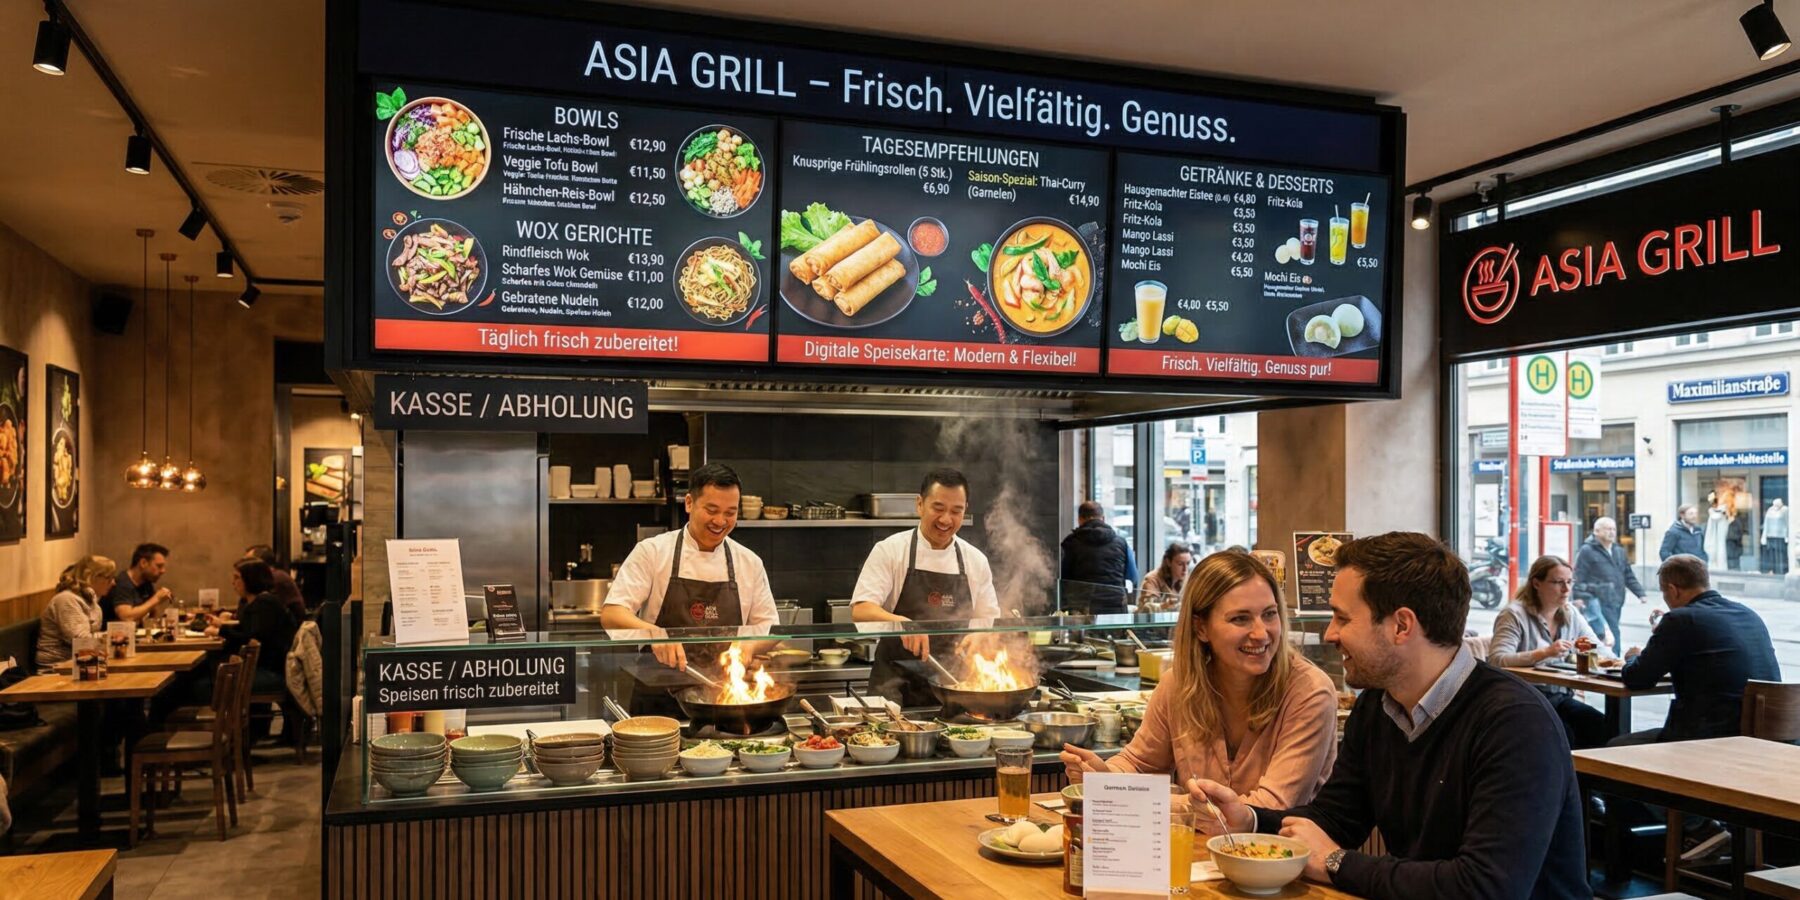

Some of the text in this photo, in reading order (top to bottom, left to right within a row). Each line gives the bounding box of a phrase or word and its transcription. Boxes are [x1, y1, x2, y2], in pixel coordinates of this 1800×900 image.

[584, 41, 677, 85] ASIA
[692, 52, 796, 98] GRILL
[843, 69, 953, 115] Frisch.
[964, 81, 1110, 137] Vielfältig.
[1121, 101, 1237, 144] Genuss.
[555, 106, 619, 130] BOWLS
[503, 127, 544, 142] Frische
[547, 131, 610, 147] Lachs-Bowl
[629, 138, 666, 152] €12,90
[862, 135, 1039, 168] TAGESEMPFEHLUNGEN
[503, 155, 542, 171] Veggie
[544, 158, 569, 172] Tofu
[572, 161, 598, 174] Bowl
[629, 165, 666, 180] €11,50
[793, 155, 953, 181] Knusprige Frühlingsrollen (5 Stk.)
[923, 182, 950, 196] €6,90
[968, 170, 1086, 193] Saison-Spezial: Thai-Curry
[1180, 165, 1334, 195] GETRÄNKE & DESSERTS
[503, 182, 666, 206] Hähnchen-Reis-Bowl €12,50
[968, 186, 1100, 208] (Garnelen) €14,90
[1124, 183, 1188, 199] Hausgemachter
[1189, 189, 1214, 201] Eistee
[1233, 192, 1257, 205] €4,80
[1267, 195, 1303, 209] Fritz-Kola
[1123, 198, 1256, 219] Fritz-Kola €3,50
[516, 220, 653, 246] WOX GERICHTE
[1123, 213, 1255, 234] Fritz-Kola €3,50
[1122, 228, 1255, 249] Mango Lassi €3,50
[502, 245, 664, 267] Rindfleisch Wok €13,90
[1122, 243, 1254, 263] Mango Lassi €4,20
[1356, 257, 1378, 269] €5,50
[1530, 209, 1781, 297] ASIA GRILL
[502, 263, 664, 284] Scharfes Wok Gemüse €11,00
[1121, 259, 1254, 278] Mochi Eis €5,50
[1264, 271, 1301, 283] Mochi Eis
[502, 290, 664, 311] Gebratene Nudeln €12,00
[1205, 300, 1229, 313] €5,50
[478, 329, 678, 352] Täglich frisch zubereitet!
[804, 340, 1077, 367] Digitale Speisekarte: Modern & Flexibel!
[1161, 355, 1332, 378] Frisch. Vielfältig. Genuss pur!
[1535, 363, 1549, 386] H
[1571, 369, 1585, 392] H
[1672, 375, 1781, 399] Maximilianstraße
[390, 391, 634, 419] KASSE / ABHOLUNG
[1681, 452, 1785, 467] Straßenbahn-Haltestelle
[379, 656, 565, 682] KASSE / ABHOLUNG
[379, 681, 559, 706] Speisen frisch zubereitet
